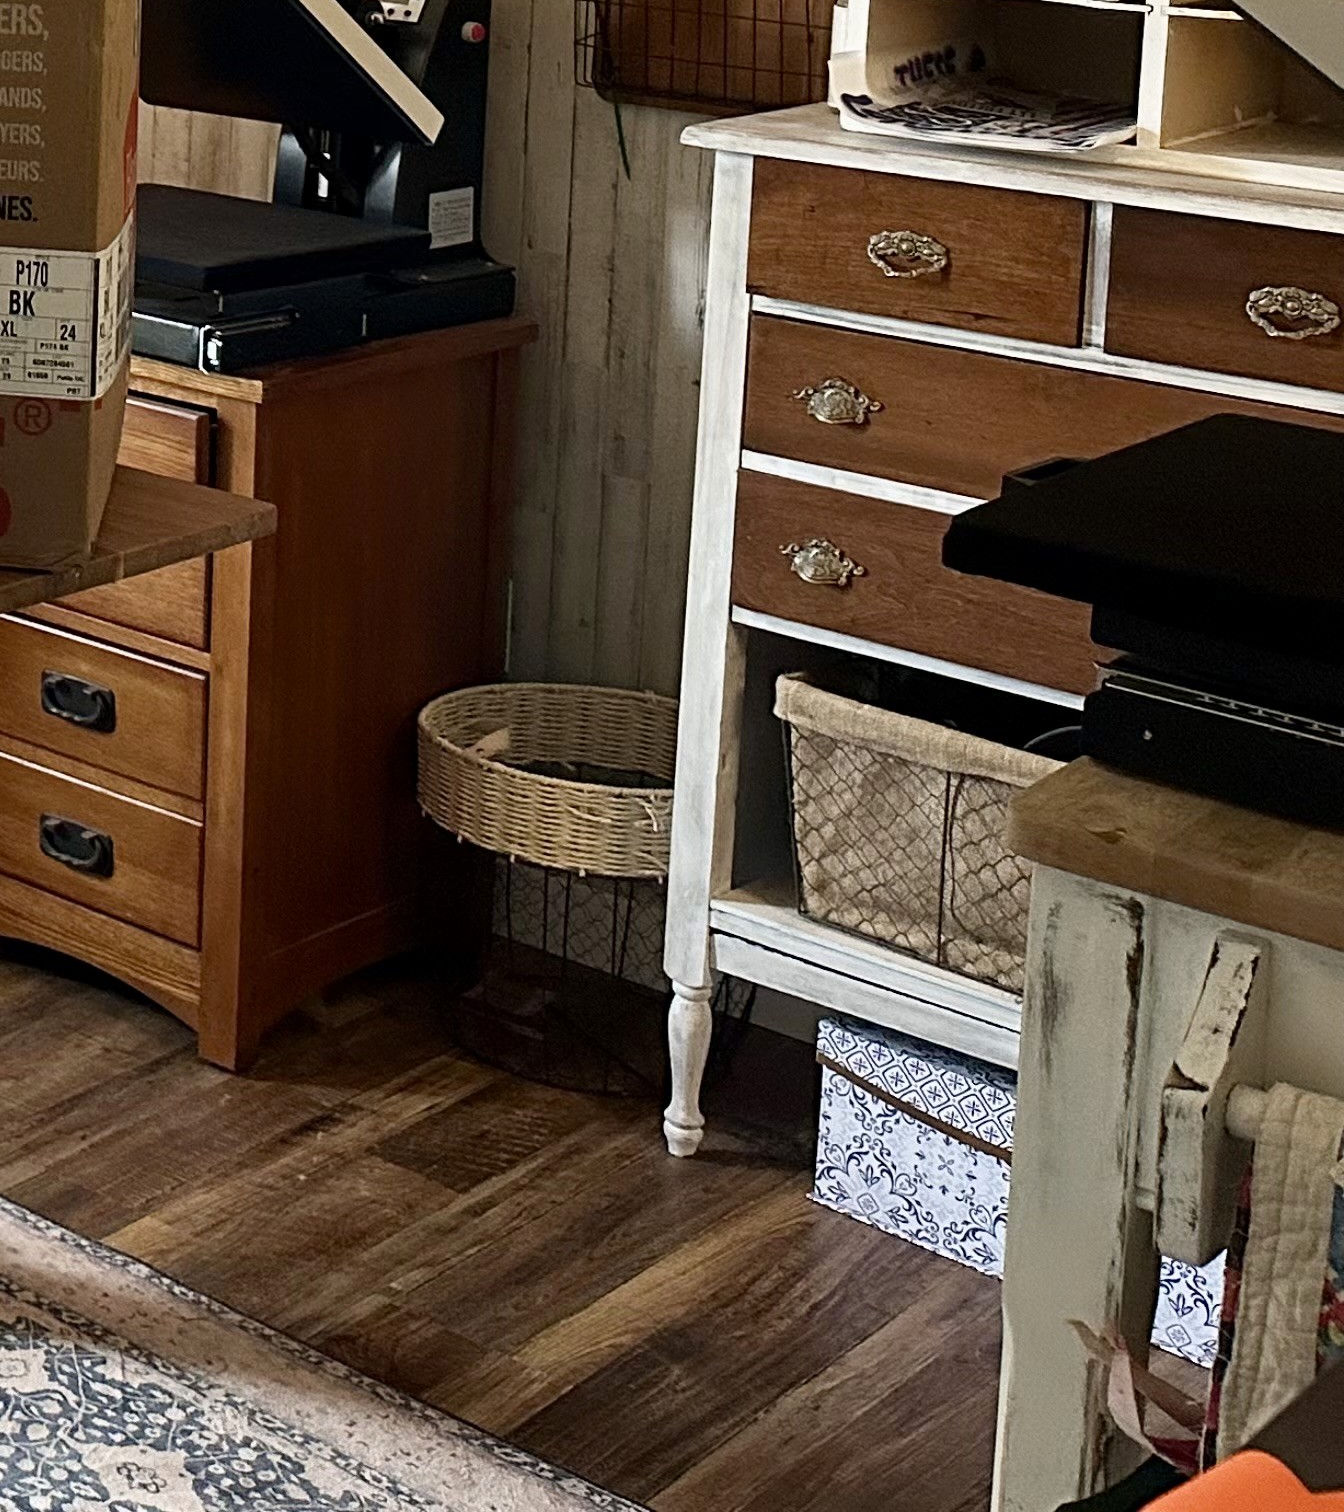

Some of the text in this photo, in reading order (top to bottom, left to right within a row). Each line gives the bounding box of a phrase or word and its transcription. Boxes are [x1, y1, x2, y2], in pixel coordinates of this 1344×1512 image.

[16, 259, 49, 288] P170
[9, 289, 36, 317] BK
[0, 320, 77, 342] XL 24
